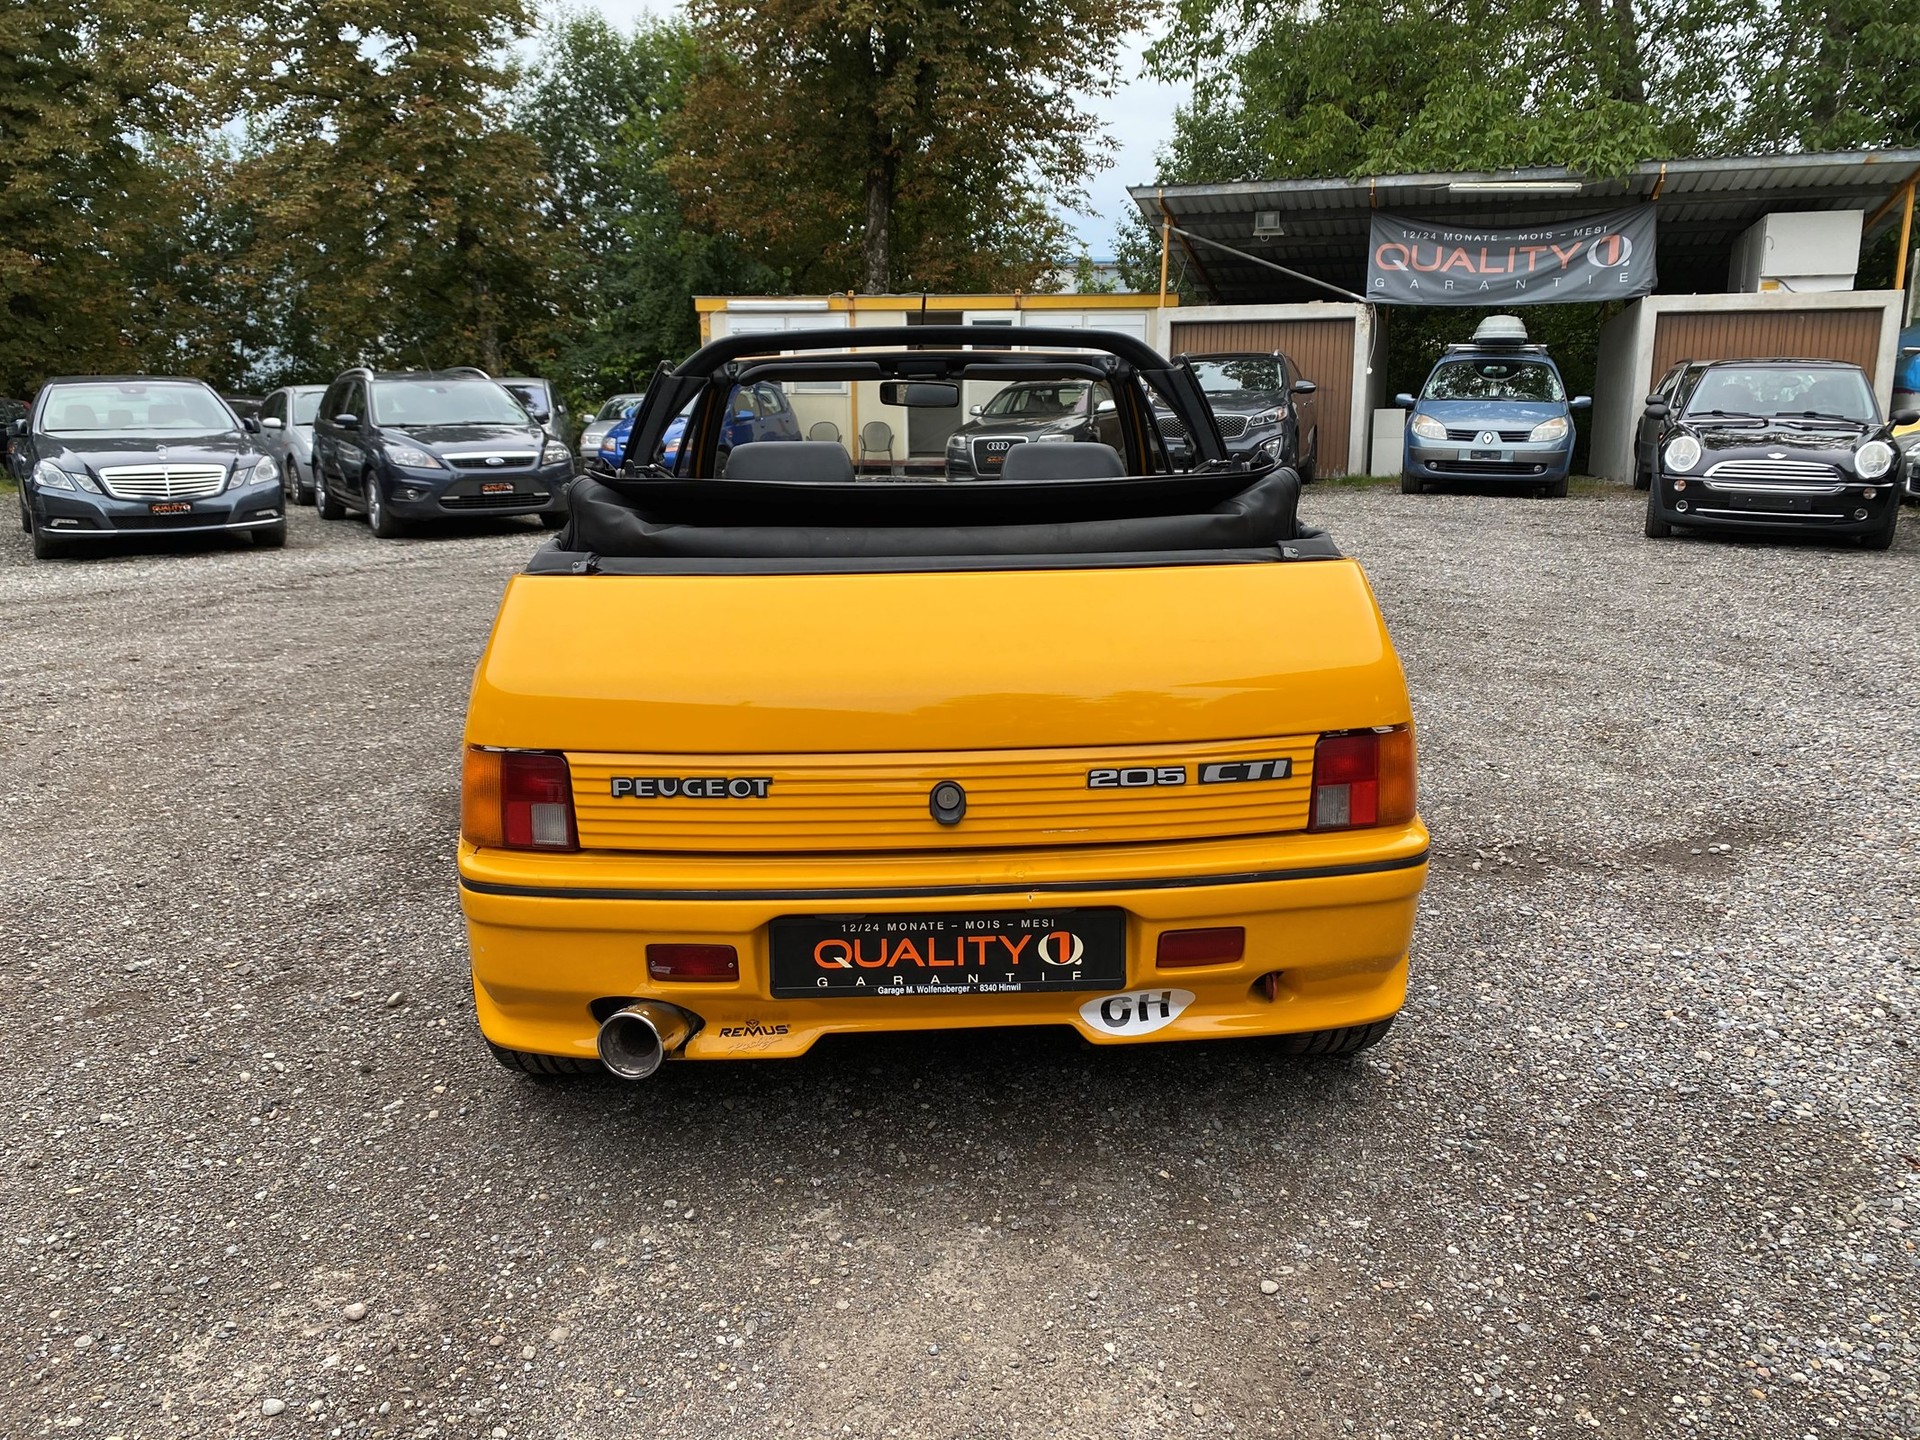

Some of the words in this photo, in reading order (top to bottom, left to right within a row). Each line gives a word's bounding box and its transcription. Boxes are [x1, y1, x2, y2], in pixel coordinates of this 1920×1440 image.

[1402, 230, 1437, 240] 12/24
[1443, 232, 1498, 241] MONATE
[1518, 231, 1553, 241] MOIS
[1573, 226, 1608, 237] MESI
[1375, 241, 1583, 273] QUALITY
[1374, 272, 1629, 290] GARANTIE
[1088, 766, 1186, 788] 205
[1202, 759, 1289, 783] CTI
[611, 777, 773, 798] PEUGEOT
[841, 923, 880, 932] 12/24
[887, 921, 945, 931] MONATE
[965, 920, 1001, 930] MOIS
[1021, 919, 1055, 928] MESI
[814, 934, 1032, 969] QUALITY
[877, 986, 905, 996] Garage
[906, 985, 915, 994] M.
[916, 984, 971, 995] Wolfensberger
[979, 983, 998, 992] 8340
[998, 983, 1022, 992] Hinwil
[1101, 990, 1171, 1027] CH
[719, 1024, 789, 1038] REMUS
